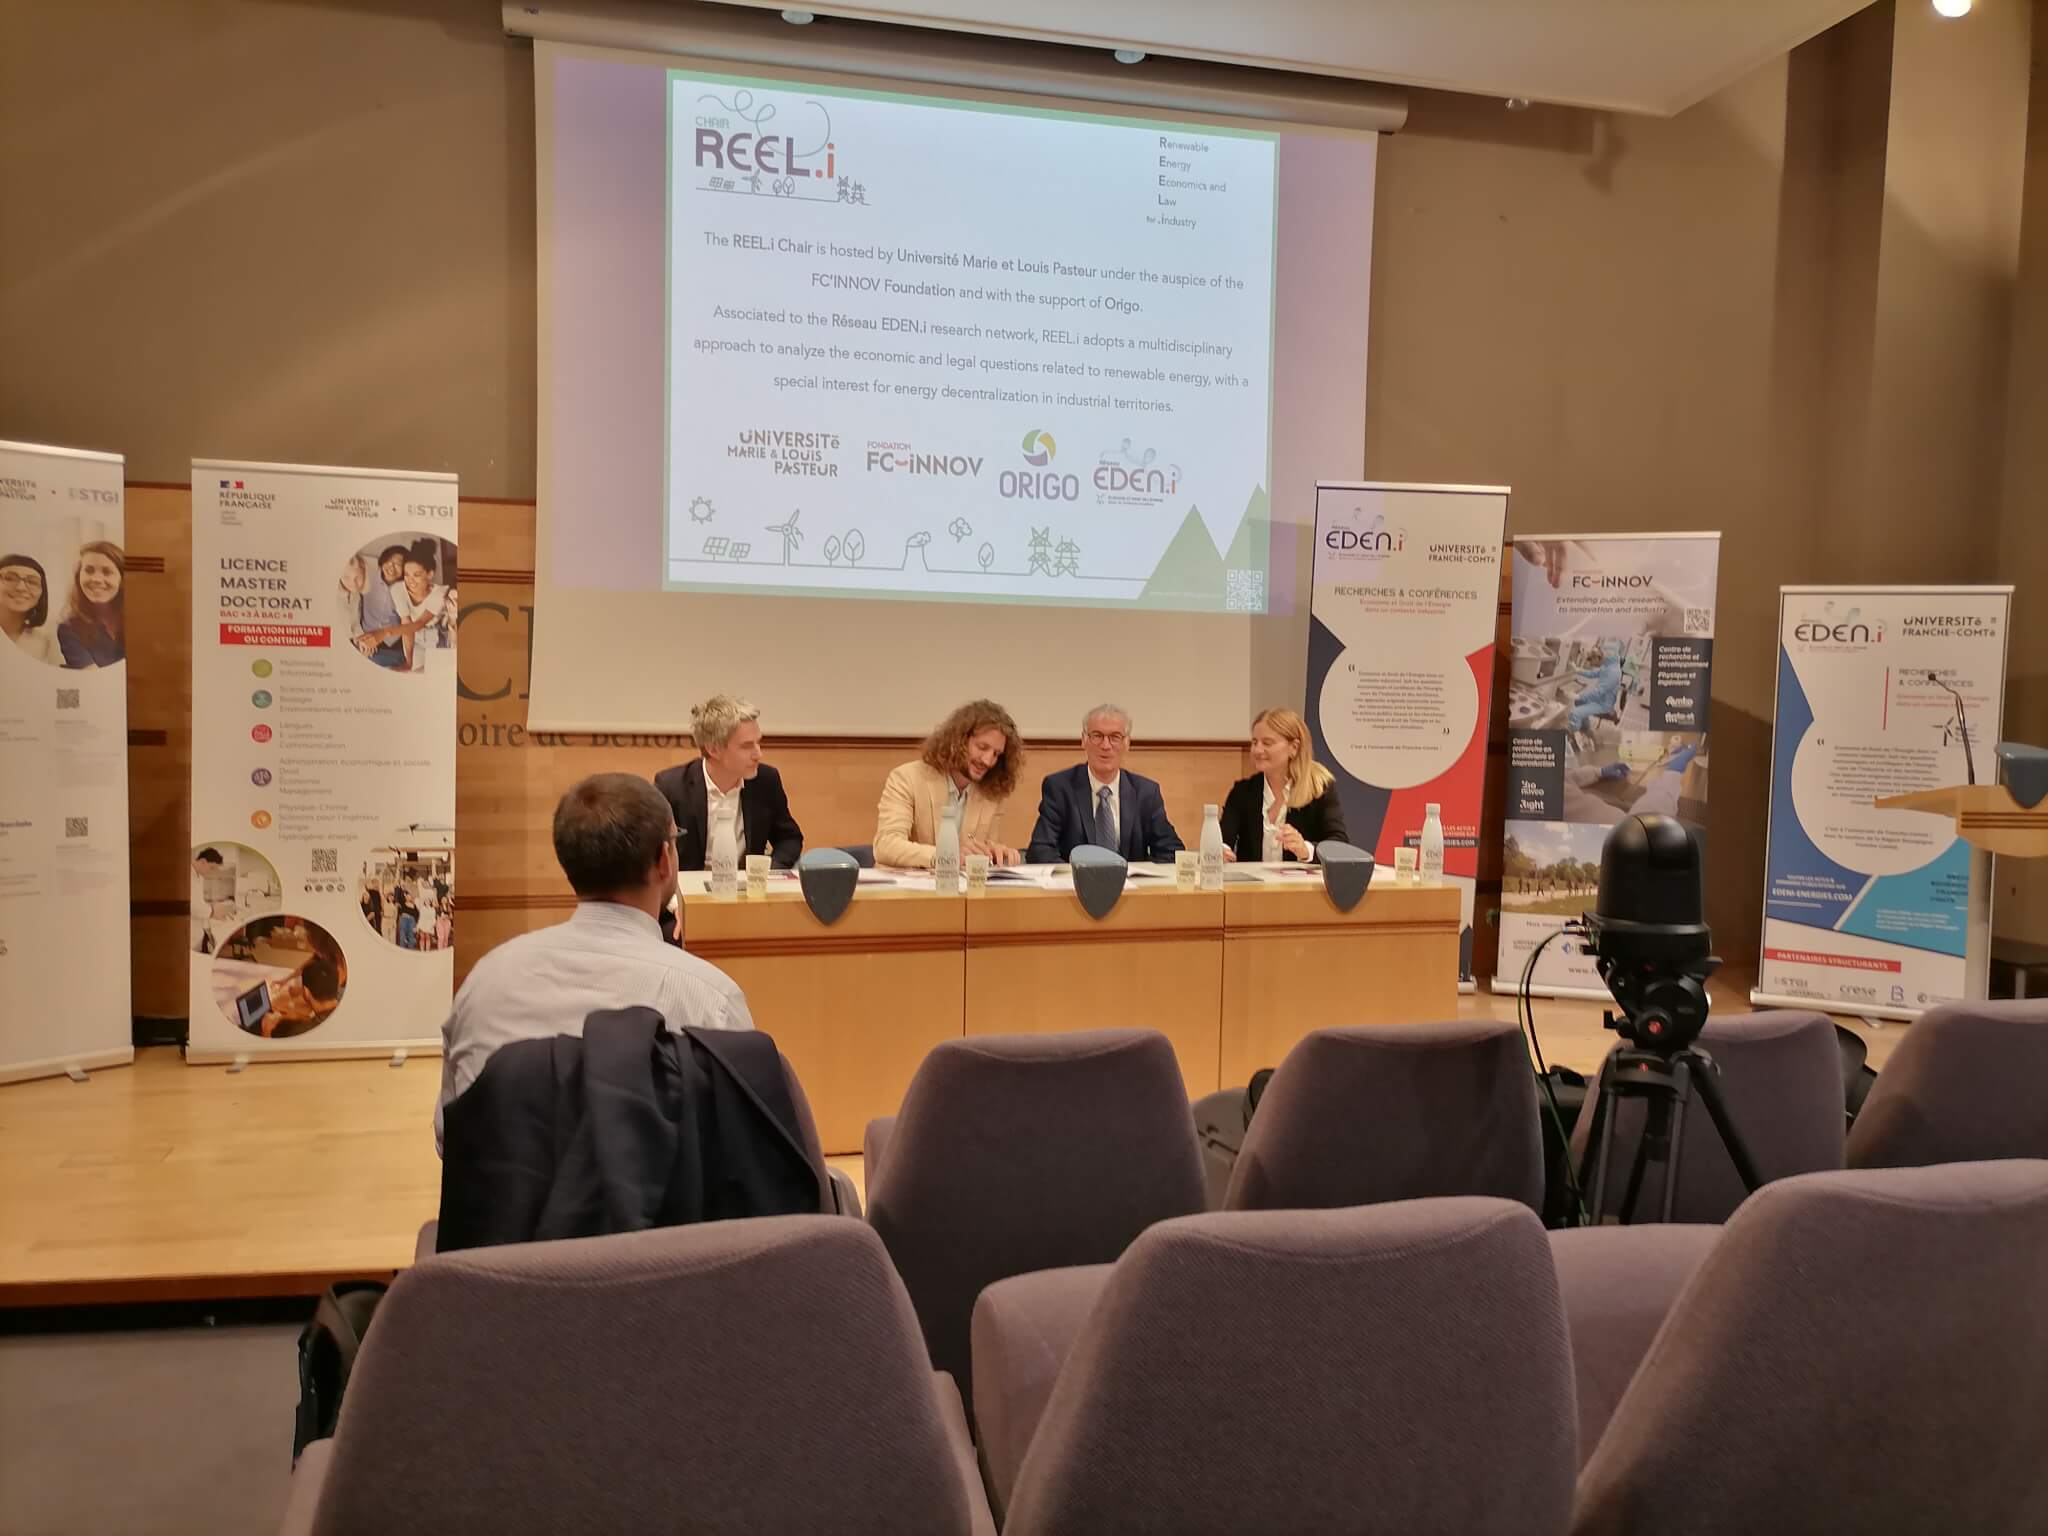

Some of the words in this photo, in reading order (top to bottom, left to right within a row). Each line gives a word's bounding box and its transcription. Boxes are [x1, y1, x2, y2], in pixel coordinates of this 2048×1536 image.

[695, 116, 730, 129] CHAIR
[1160, 136, 1209, 153] Renewable
[1159, 155, 1191, 172] Energy
[1158, 174, 1207, 191] Economics
[1209, 181, 1226, 193] and
[1158, 193, 1177, 207] Law
[704, 231, 729, 247] The
[733, 234, 775, 251] REEL.i
[778, 238, 812, 254] Chair
[816, 242, 826, 256] is
[830, 242, 874, 260] hosted
[878, 246, 893, 264] by
[897, 249, 959, 267] Université
[962, 254, 998, 270] Marie
[1001, 259, 1014, 272] et
[1017, 257, 1049, 274] Louis
[1053, 261, 1097, 278] Pasteur
[1100, 266, 1136, 281] under
[1139, 269, 1158, 283] the
[1162, 273, 1206, 289] auspice
[1210, 275, 1222, 288] of
[1225, 276, 1244, 290] the
[812, 272, 880, 292] FC'INNOV
[884, 277, 956, 298] Foundation
[959, 286, 983, 300] and
[986, 288, 1012, 302] with
[1016, 290, 1035, 304] the
[1039, 293, 1086, 310] support
[1089, 295, 1102, 309] of
[1104, 296, 1143, 315] Origo.
[713, 304, 785, 323] Associated
[790, 311, 803, 325] to
[807, 311, 828, 327] the
[832, 313, 877, 331] Réseau
[881, 316, 927, 334] EDEN.i
[930, 322, 982, 338] research
[985, 328, 1038, 344] network,
[1042, 329, 1080, 345] REEL.i
[1083, 333, 1124, 349] adopts
[1128, 338, 1135, 349] a
[1138, 336, 1233, 359] multidisciplinary
[693, 337, 756, 354] approach
[760, 341, 774, 355] to
[777, 342, 825, 360] analyze
[829, 345, 850, 360] the
[853, 349, 915, 365] economic
[919, 352, 942, 367] and
[946, 353, 976, 371] legal
[980, 357, 1039, 374] questions
[1042, 361, 1085, 377] related
[1088, 364, 1101, 378] to
[1104, 365, 1166, 382] renewable
[1169, 371, 1211, 388] energy,
[1215, 373, 1239, 388] with
[1242, 377, 1249, 388] a
[773, 374, 818, 391] special
[822, 377, 870, 393] interest
[873, 379, 891, 394] for
[894, 383, 938, 400] energy
[941, 385, 1039, 404] decentralization
[1042, 391, 1053, 405] in
[1056, 391, 1111, 409] industrial
[1114, 397, 1174, 413] territories.
[867, 440, 912, 451] FONDATION
[770, 449, 778, 460] &
[999, 470, 1080, 502] ORIGO
[80, 487, 119, 504] STGI
[219, 490, 276, 502] RÉPUBLIQUE
[219, 499, 273, 511] FRANÇAISE
[416, 503, 455, 519] STGI
[220, 557, 288, 573] LICENCE
[220, 576, 288, 591] MASTER
[1334, 586, 1396, 598] RECHERCHES
[220, 595, 313, 611] DOCTORAT
[1556, 596, 1598, 605] Extending
[1600, 596, 1625, 606] public
[1627, 596, 1665, 605] research
[220, 610, 239, 619] BAC
[241, 610, 253, 620] +3
[261, 611, 280, 620] BAC
[1558, 606, 1568, 614] to
[1569, 605, 1614, 614] innovation
[1615, 606, 1632, 614] and
[1633, 606, 1669, 616] industry
[227, 624, 286, 636] FORMATION
[286, 626, 324, 637] INITIALE
[244, 635, 258, 645] OU
[259, 635, 308, 646] CONTINUE
[1658, 645, 1681, 654] Centre
[1658, 653, 1691, 661] recherche
[1512, 737, 1533, 746] Centre
[1776, 952, 1827, 965] PARTENAIRES
[1828, 956, 1889, 970] STRUCTURANTS
